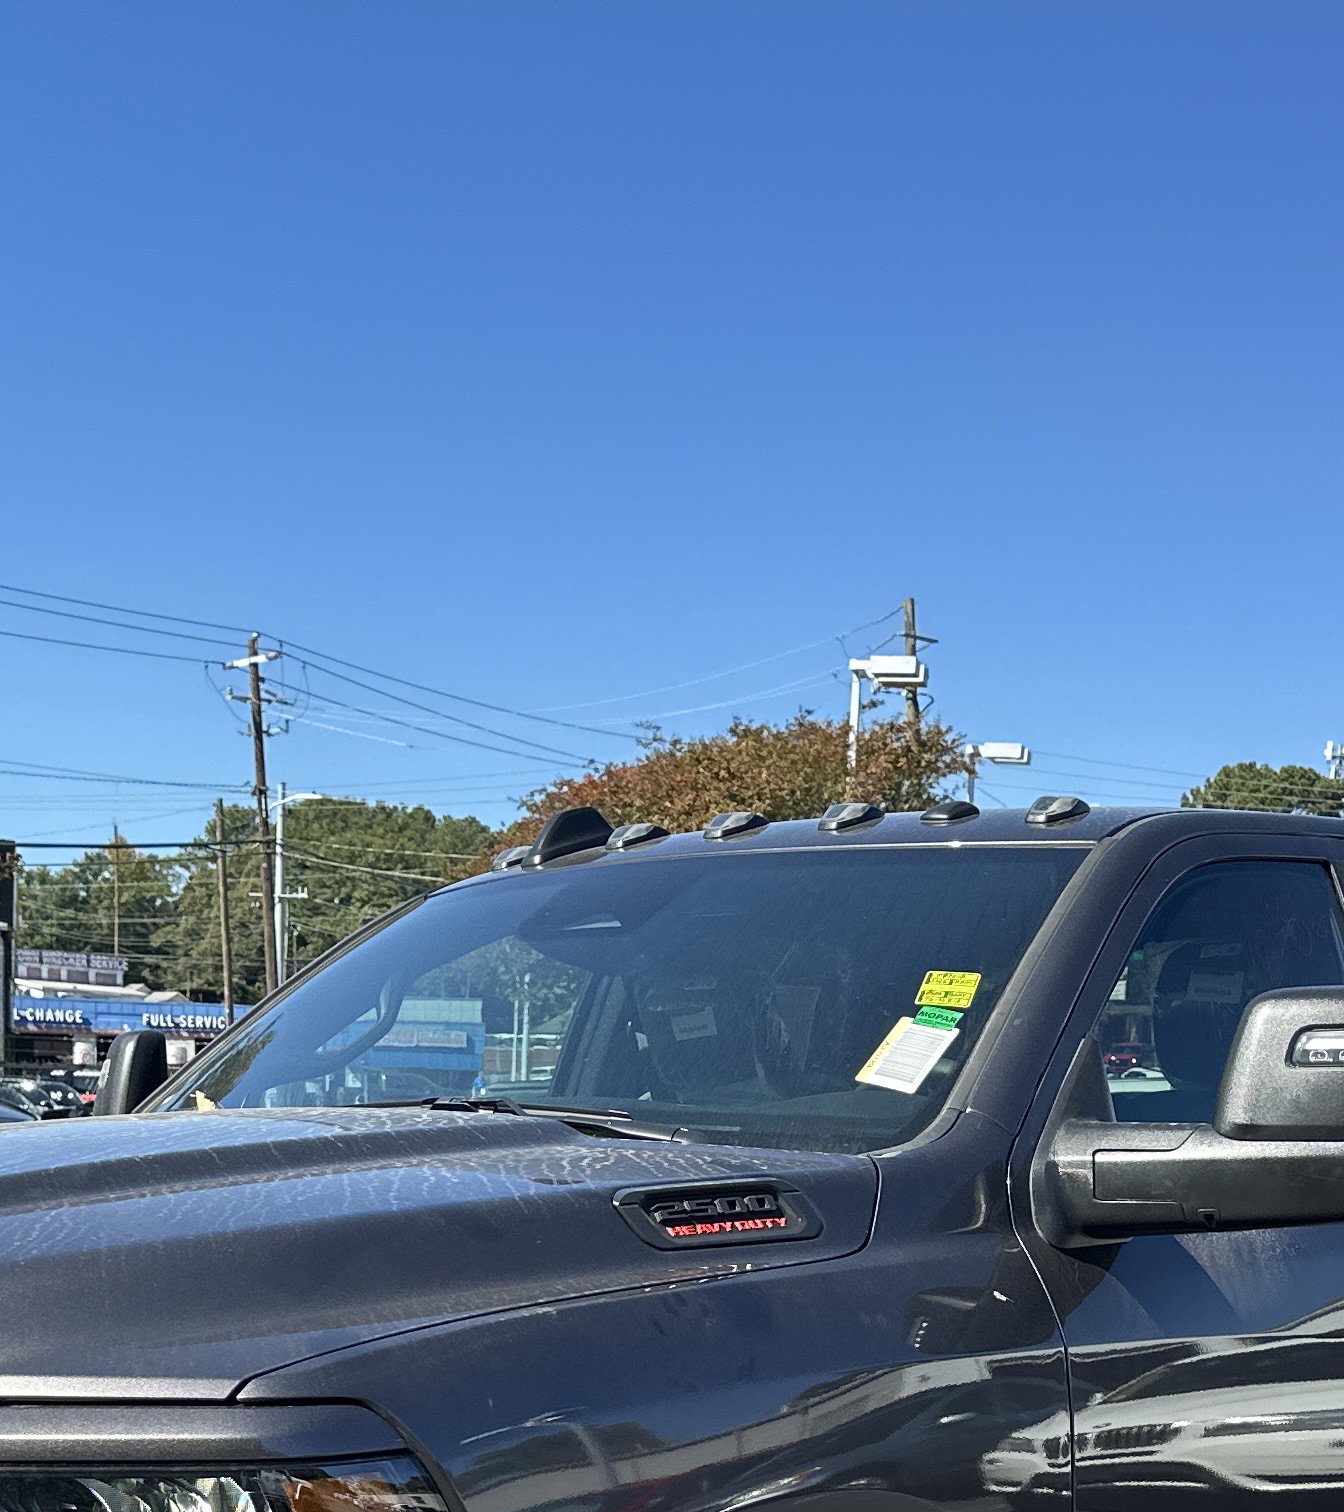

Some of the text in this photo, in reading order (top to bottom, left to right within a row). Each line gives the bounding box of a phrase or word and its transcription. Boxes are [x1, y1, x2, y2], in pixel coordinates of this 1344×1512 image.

[178, 1015, 227, 1029] SERVIC
[917, 1010, 958, 1024] MOPAR
[650, 1194, 779, 1224] 2500
[665, 1216, 788, 1238] HEAVY DUTY
